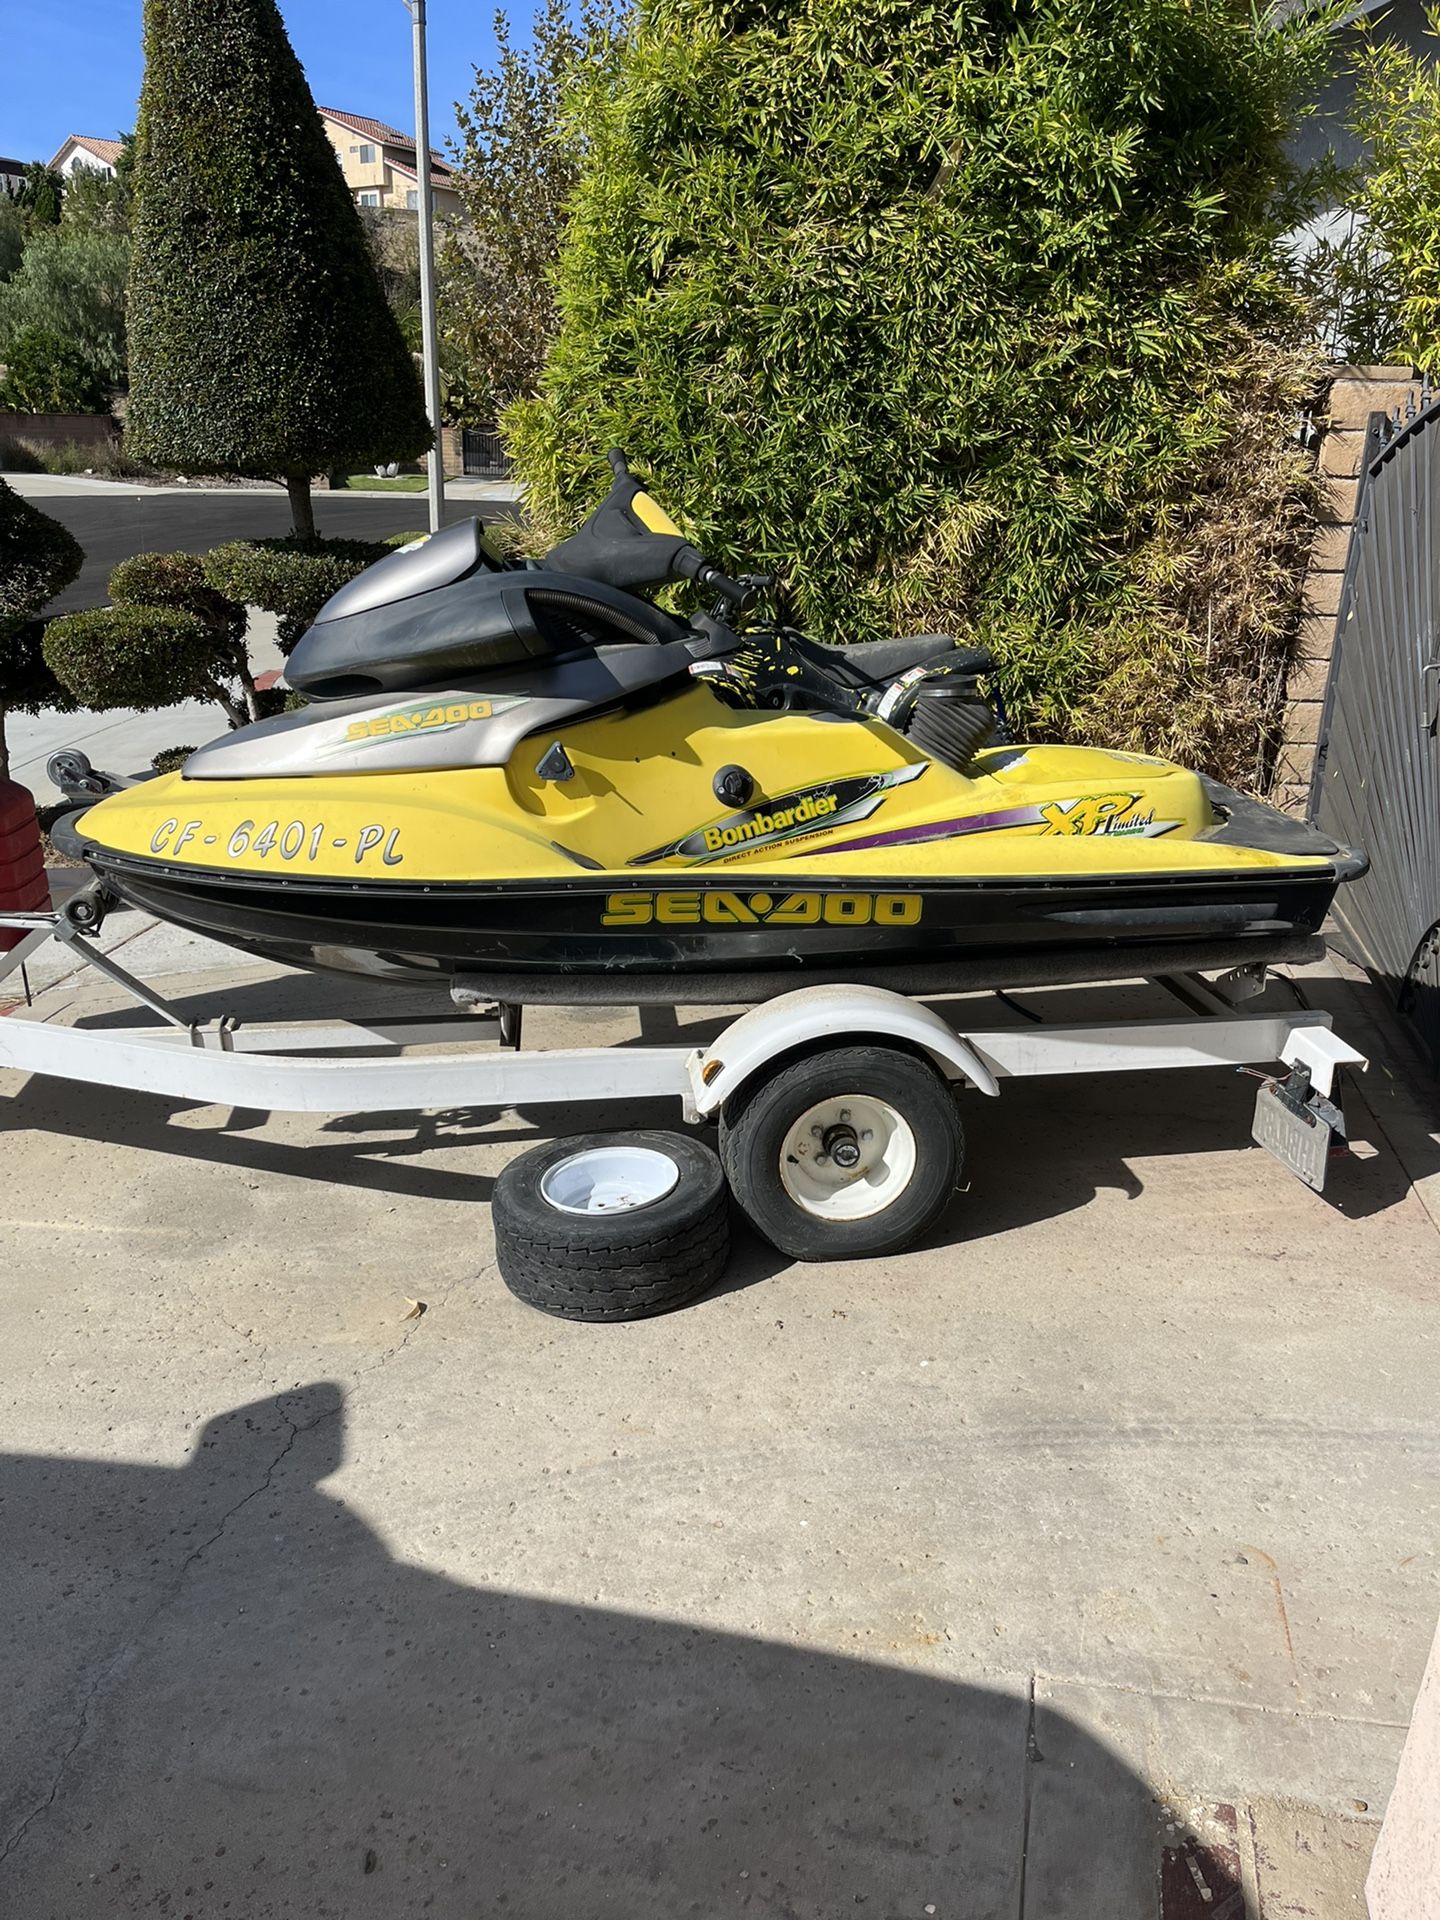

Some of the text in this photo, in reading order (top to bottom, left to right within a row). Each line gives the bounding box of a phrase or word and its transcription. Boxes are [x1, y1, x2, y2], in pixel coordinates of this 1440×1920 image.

[703, 794, 839, 851] Bombardier
[1040, 793, 1156, 836] XP Limited
[723, 829, 834, 864] DIRECT ACTION SUSPENSION
